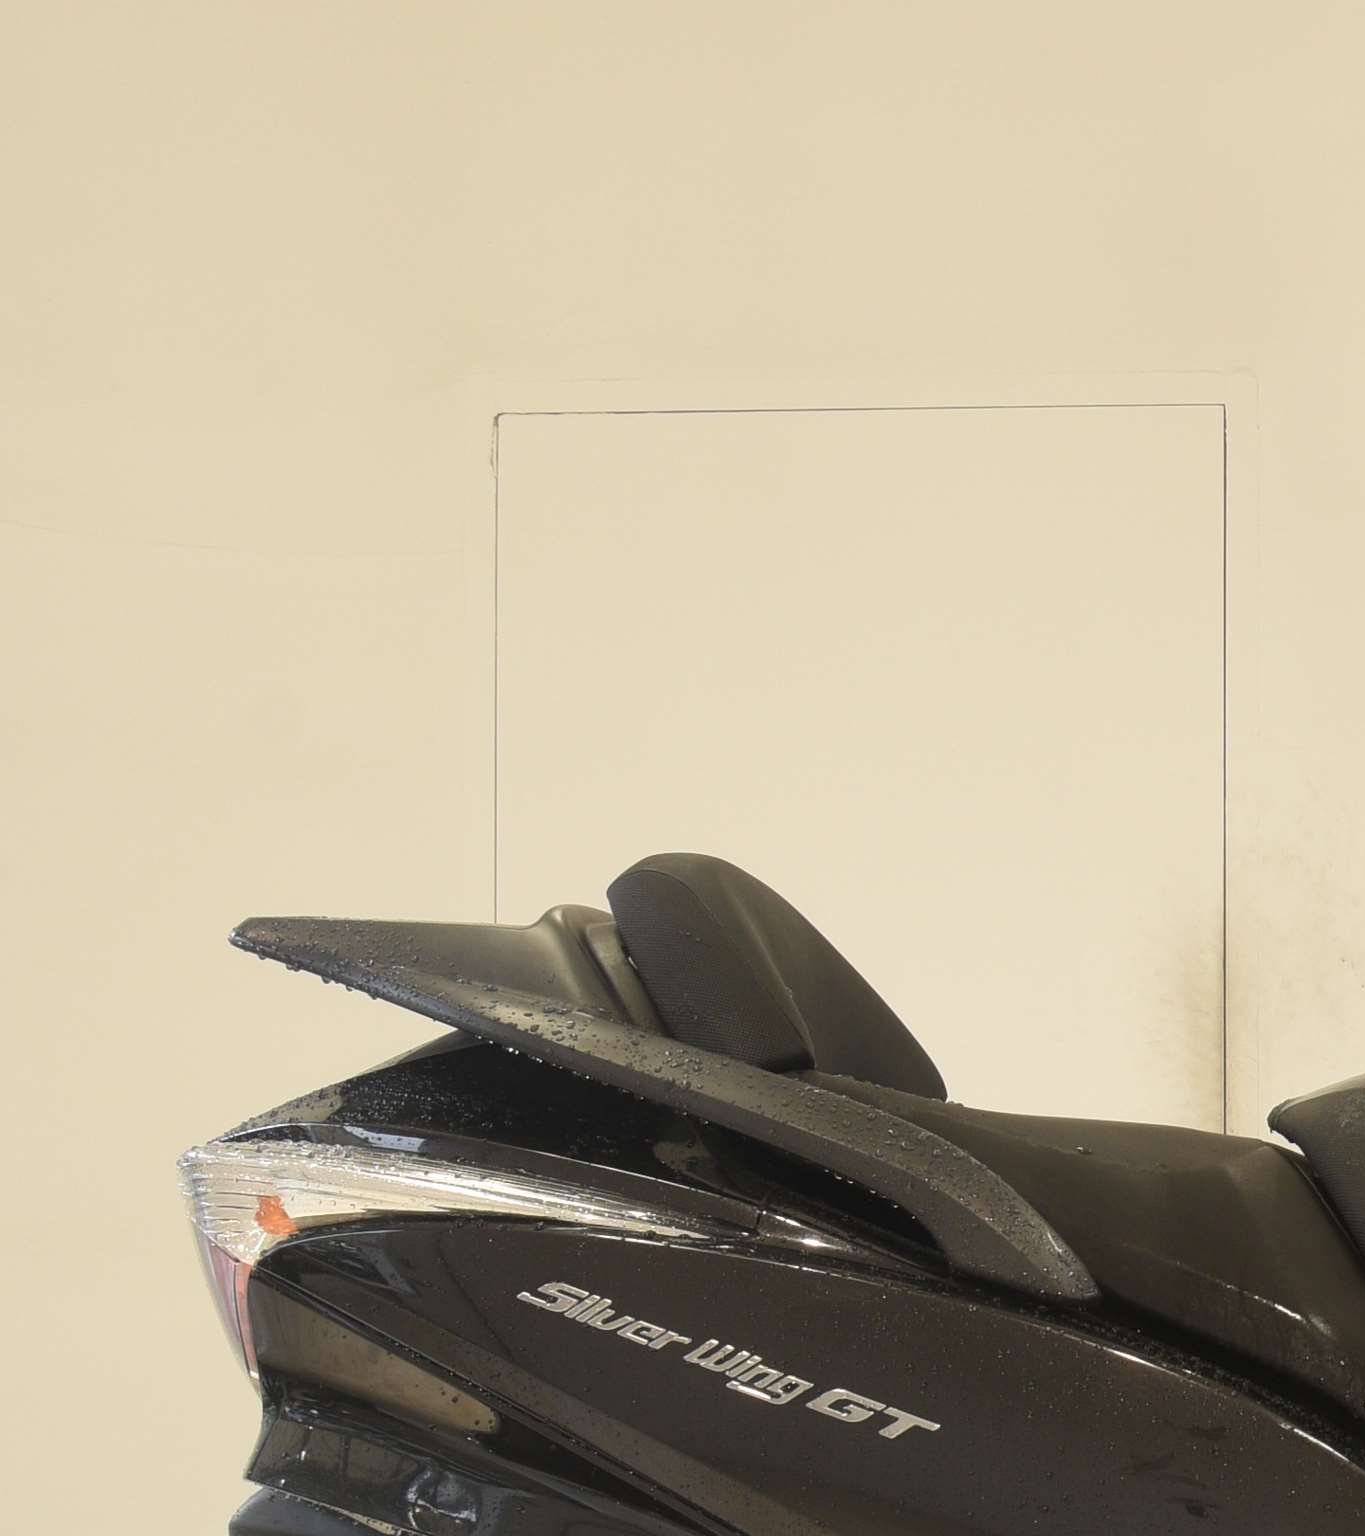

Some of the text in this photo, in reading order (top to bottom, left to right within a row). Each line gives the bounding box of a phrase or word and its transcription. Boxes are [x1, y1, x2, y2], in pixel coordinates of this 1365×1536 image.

[516, 1281, 941, 1440] Silver Wing GT
